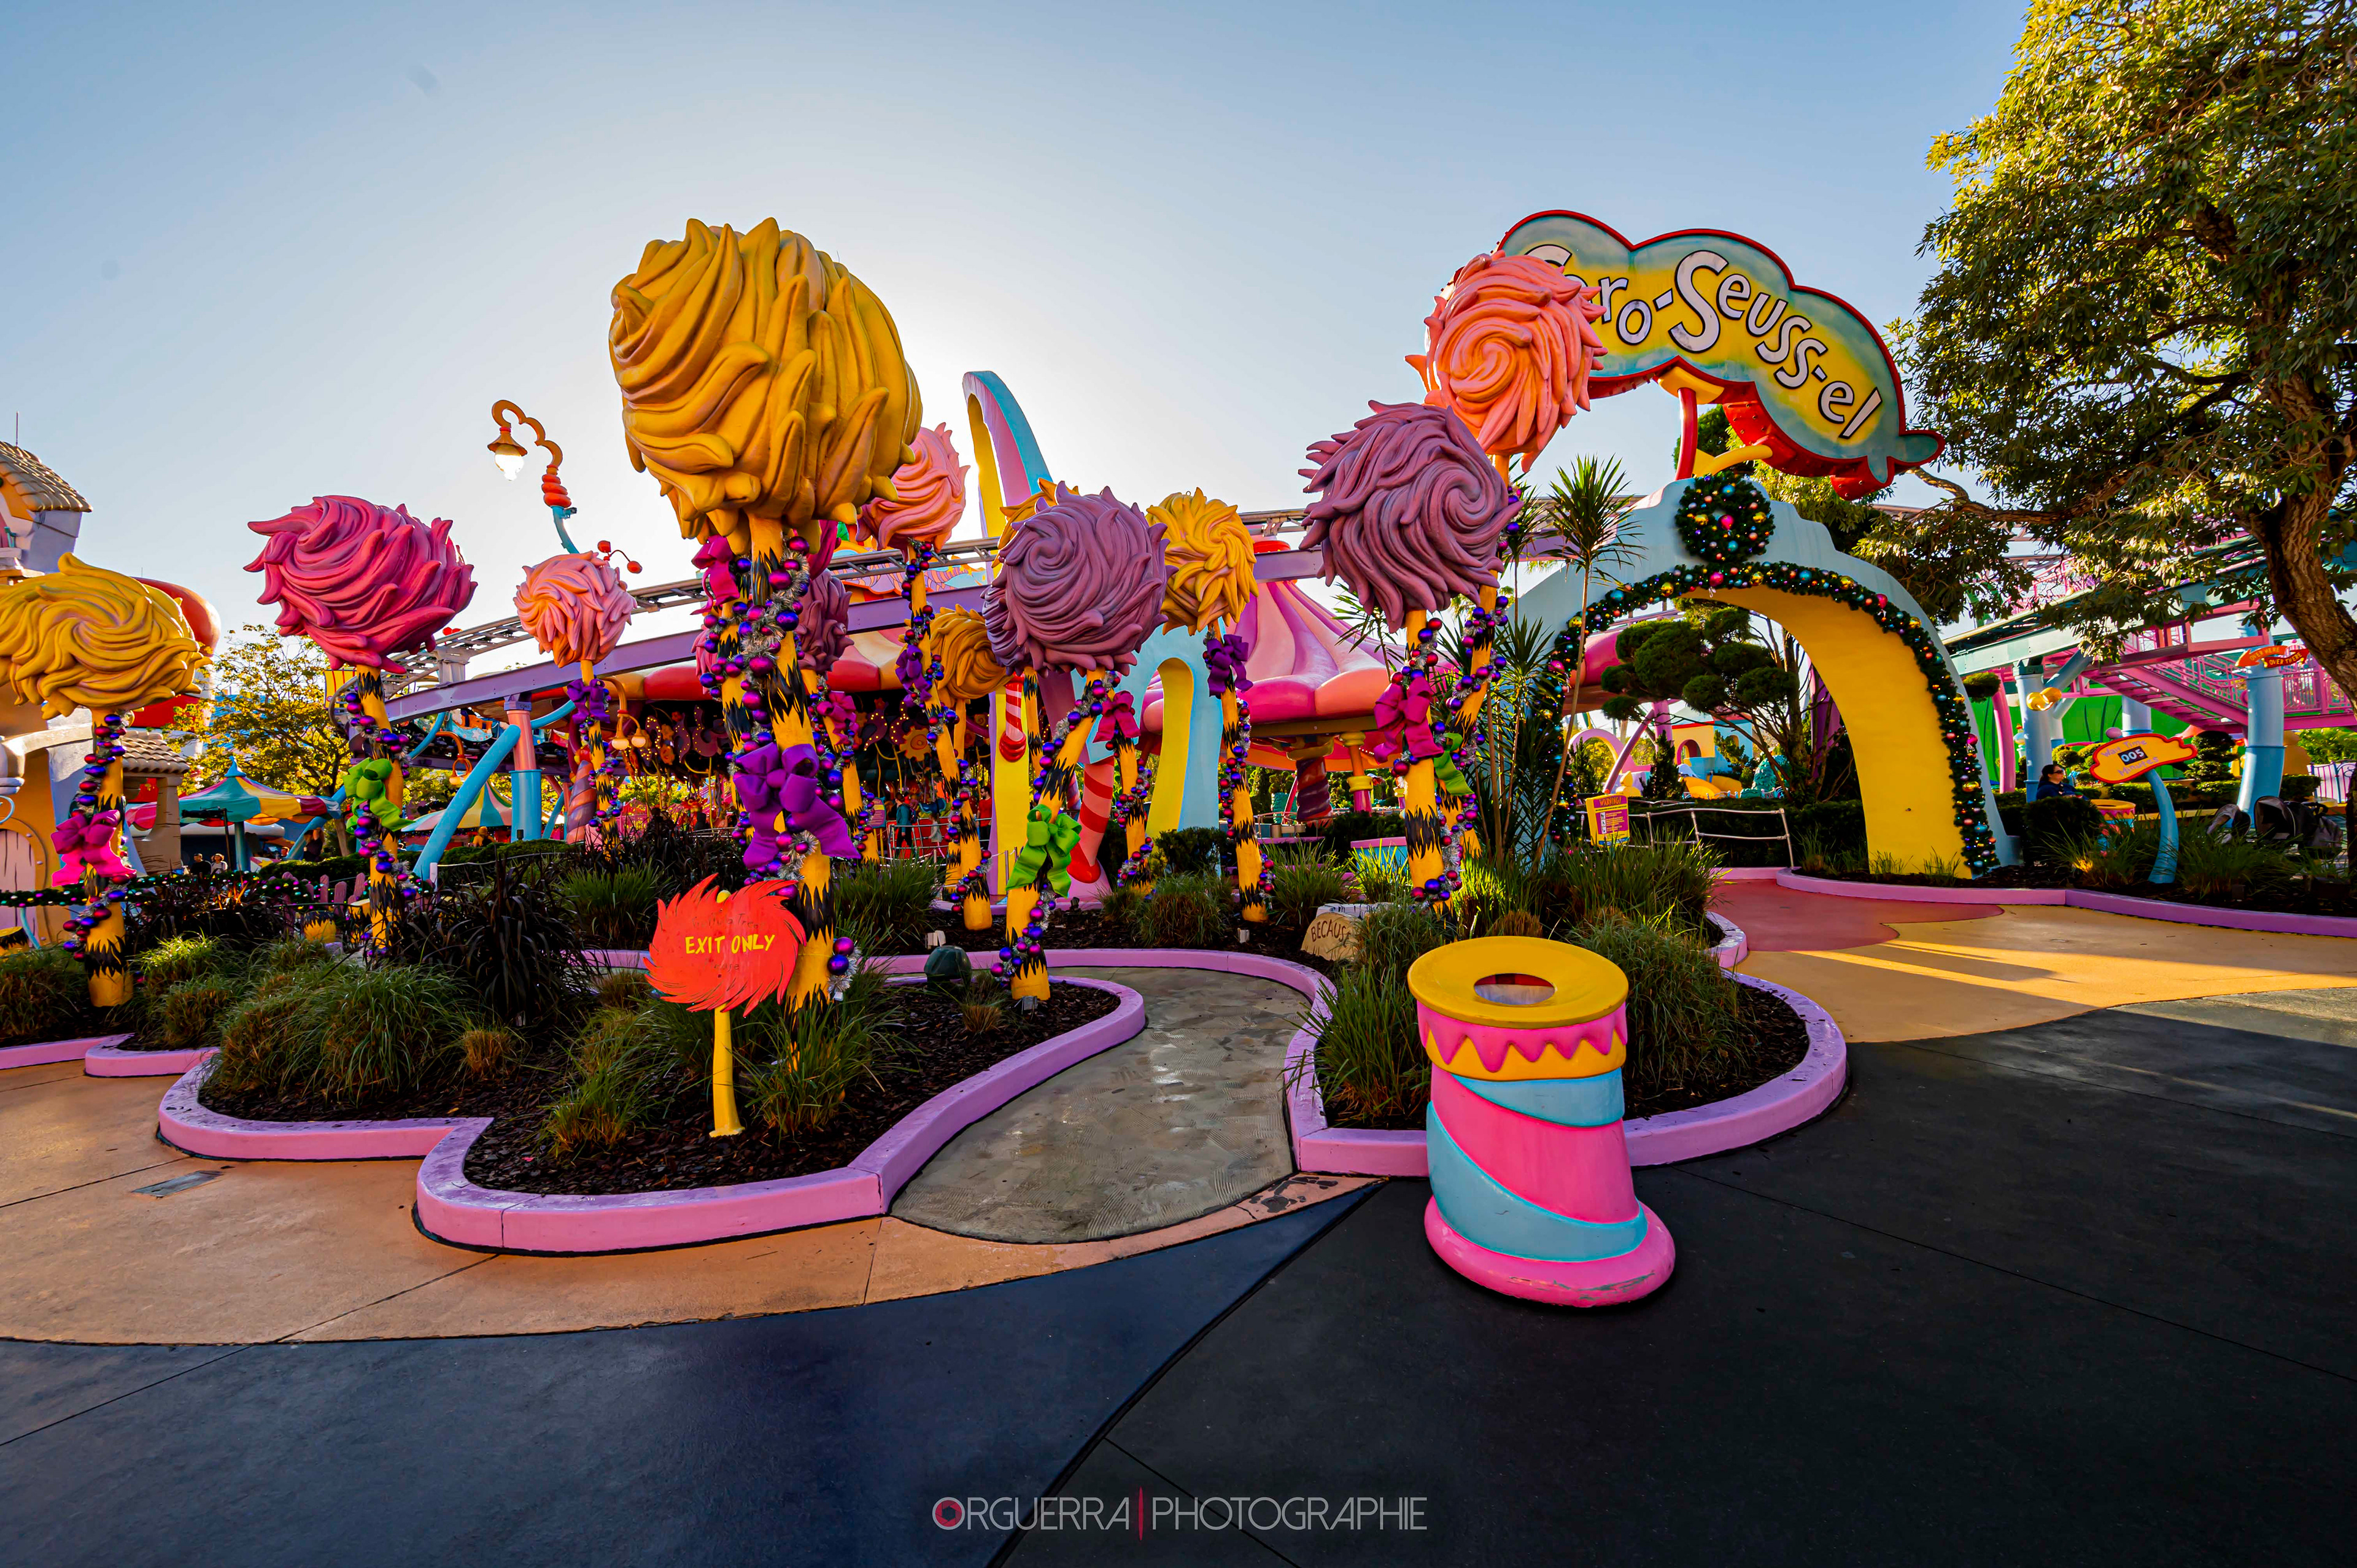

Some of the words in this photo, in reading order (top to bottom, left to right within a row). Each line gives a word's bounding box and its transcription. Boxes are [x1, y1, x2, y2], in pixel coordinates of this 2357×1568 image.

[1524, 244, 1883, 439] ro-Seuss-el
[2250, 651, 2264, 661] OVER
[2285, 652, 2302, 663] THERE
[2121, 749, 2145, 762] 005
[2117, 756, 2159, 776] Minutes
[685, 935, 725, 954] EXIT
[731, 933, 775, 954] ONLY
